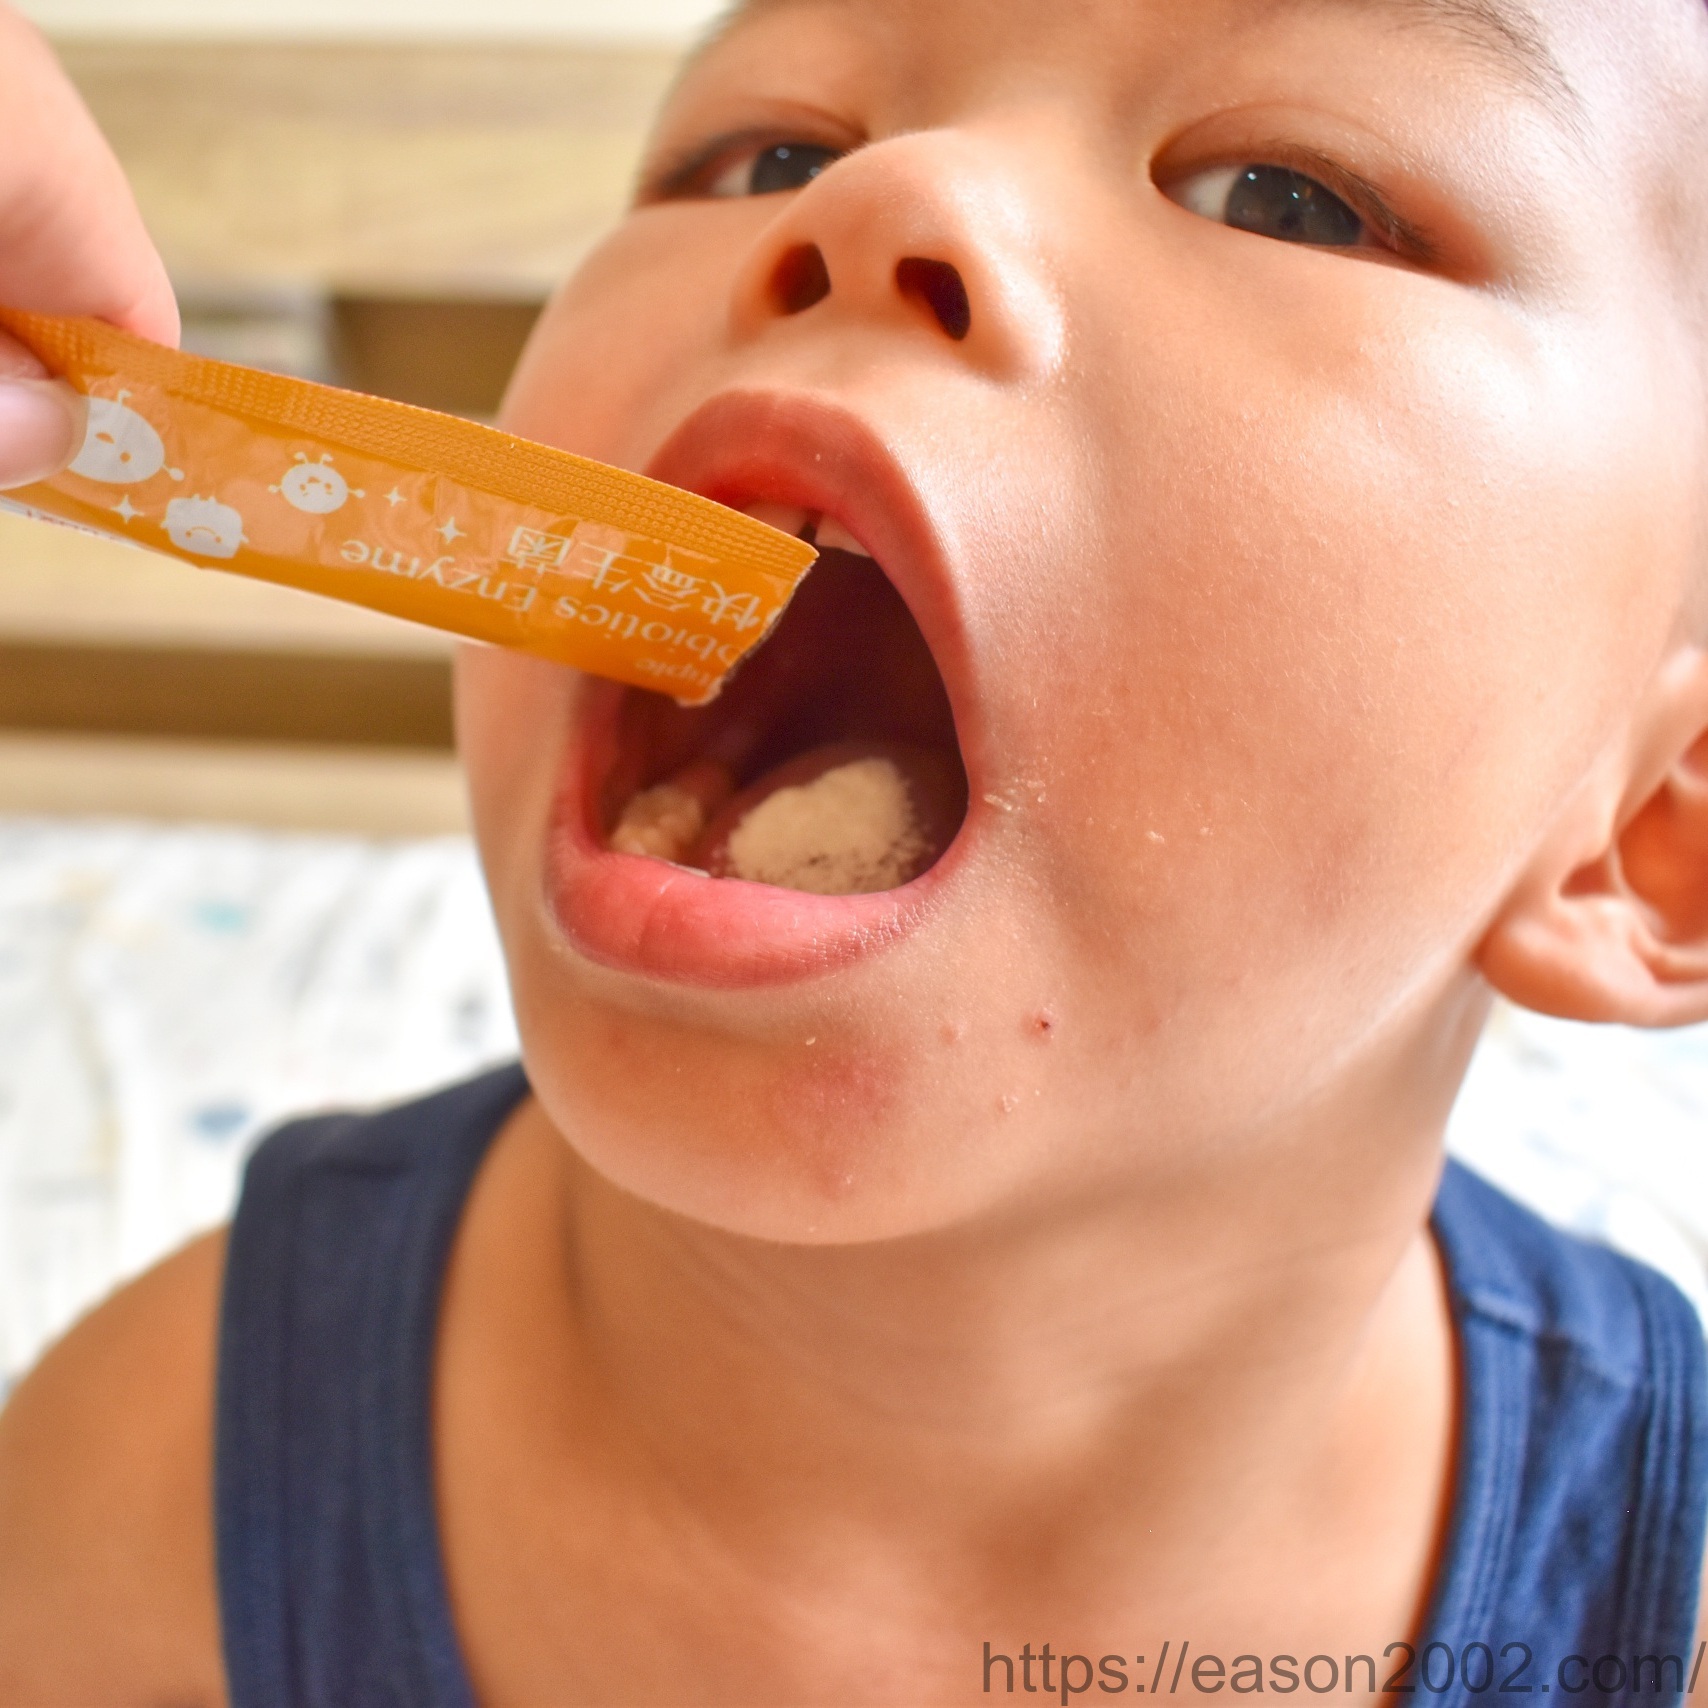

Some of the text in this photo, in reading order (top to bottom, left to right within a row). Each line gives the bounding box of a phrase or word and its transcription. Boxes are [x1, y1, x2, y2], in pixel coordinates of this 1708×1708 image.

[340, 539, 537, 612] Enzyme
[499, 525, 761, 632] 快益生菌
